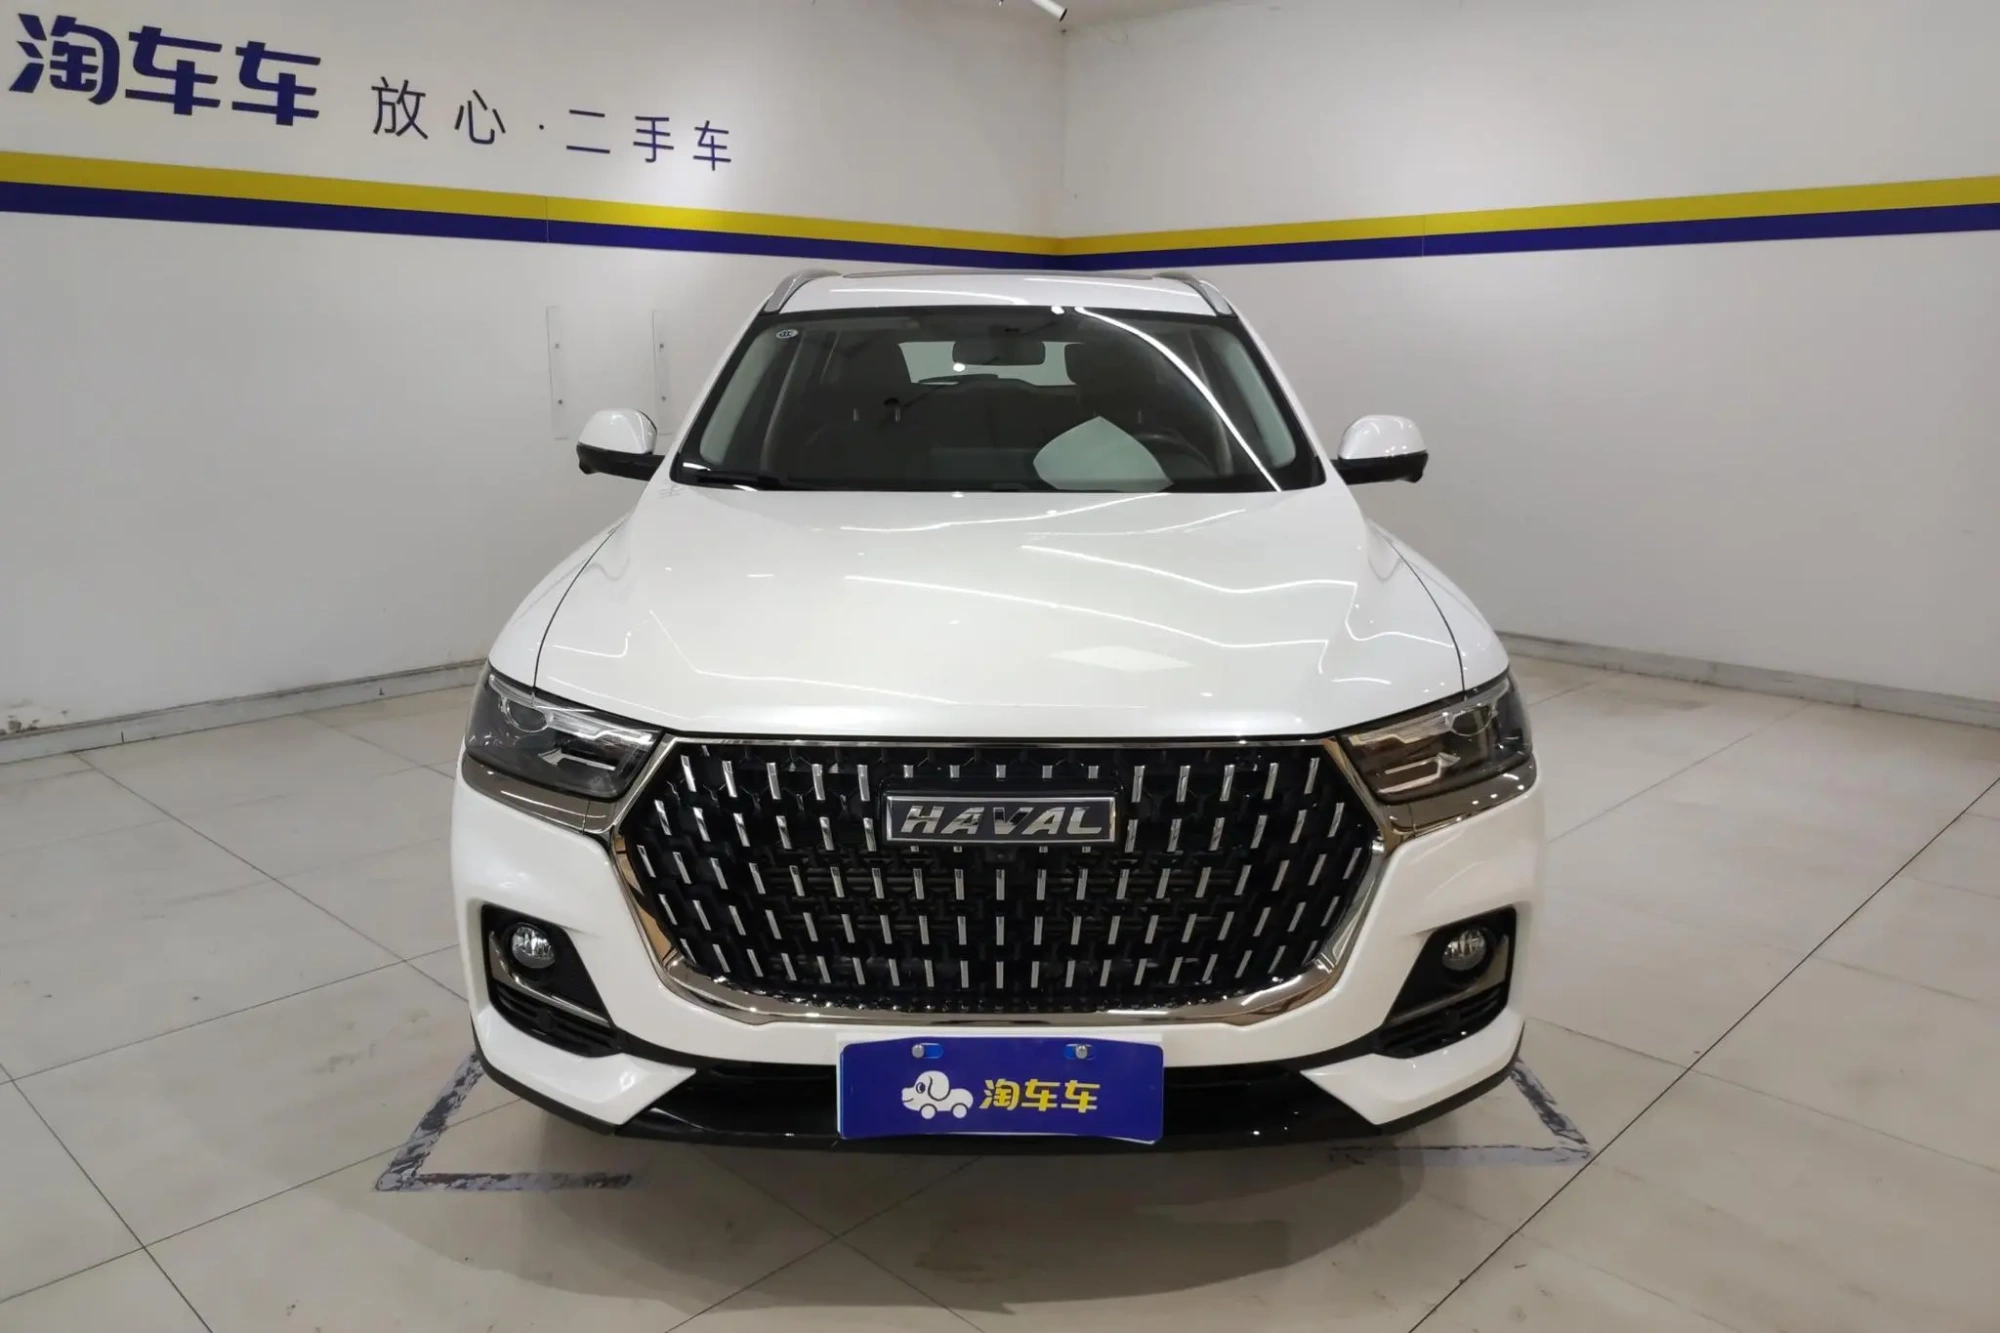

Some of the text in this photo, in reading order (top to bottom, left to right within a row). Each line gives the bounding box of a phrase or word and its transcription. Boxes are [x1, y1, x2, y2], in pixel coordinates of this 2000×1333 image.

[9, 13, 321, 126] 淘车车
[901, 805, 1102, 835] HAVAL
[979, 1078, 1101, 1112] 淘车车
